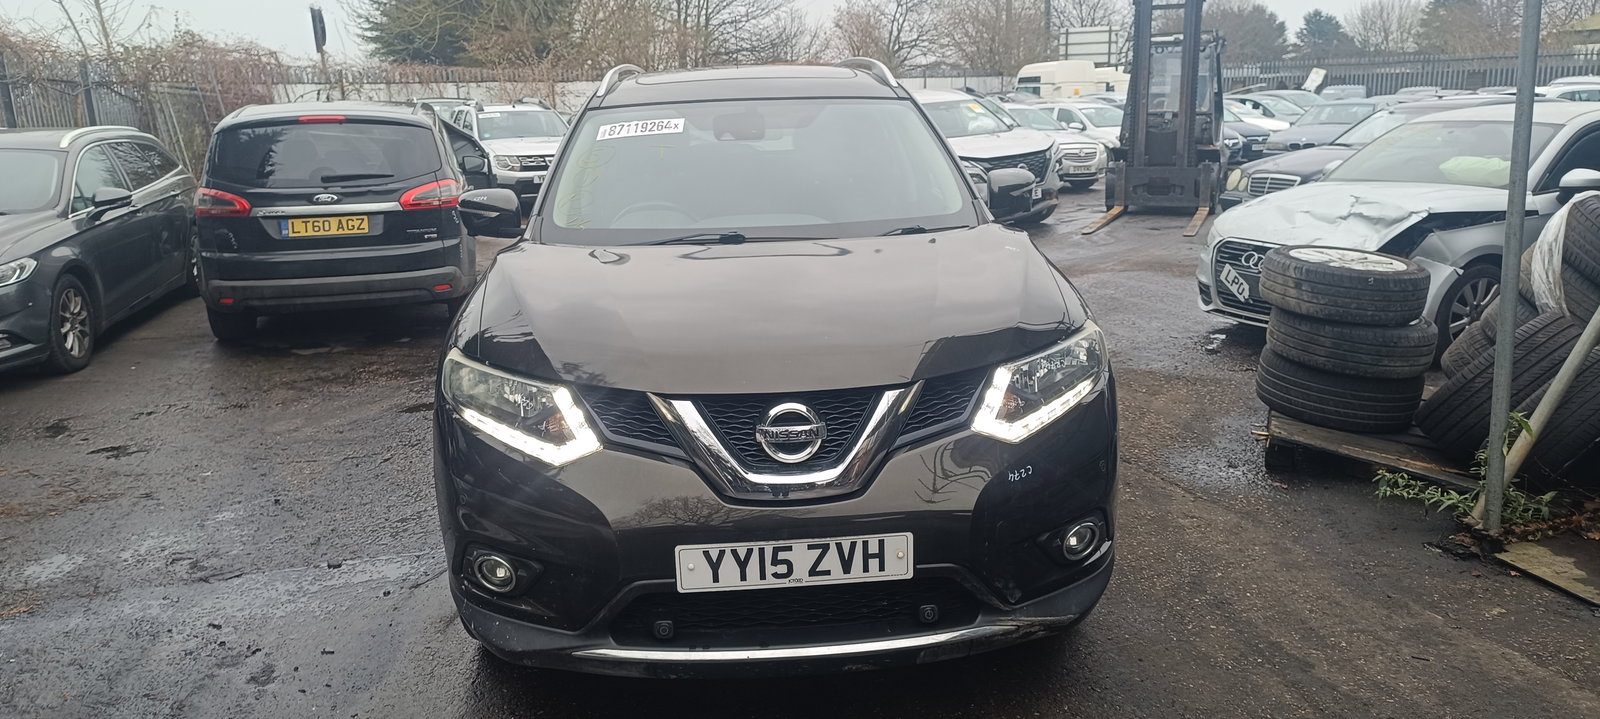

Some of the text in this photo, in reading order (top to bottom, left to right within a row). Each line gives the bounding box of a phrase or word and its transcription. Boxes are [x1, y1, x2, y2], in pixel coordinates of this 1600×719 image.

[291, 217, 366, 234] LT60 AGZ
[763, 428, 819, 440] NISSAN
[702, 538, 886, 584] YY15 ZVH
